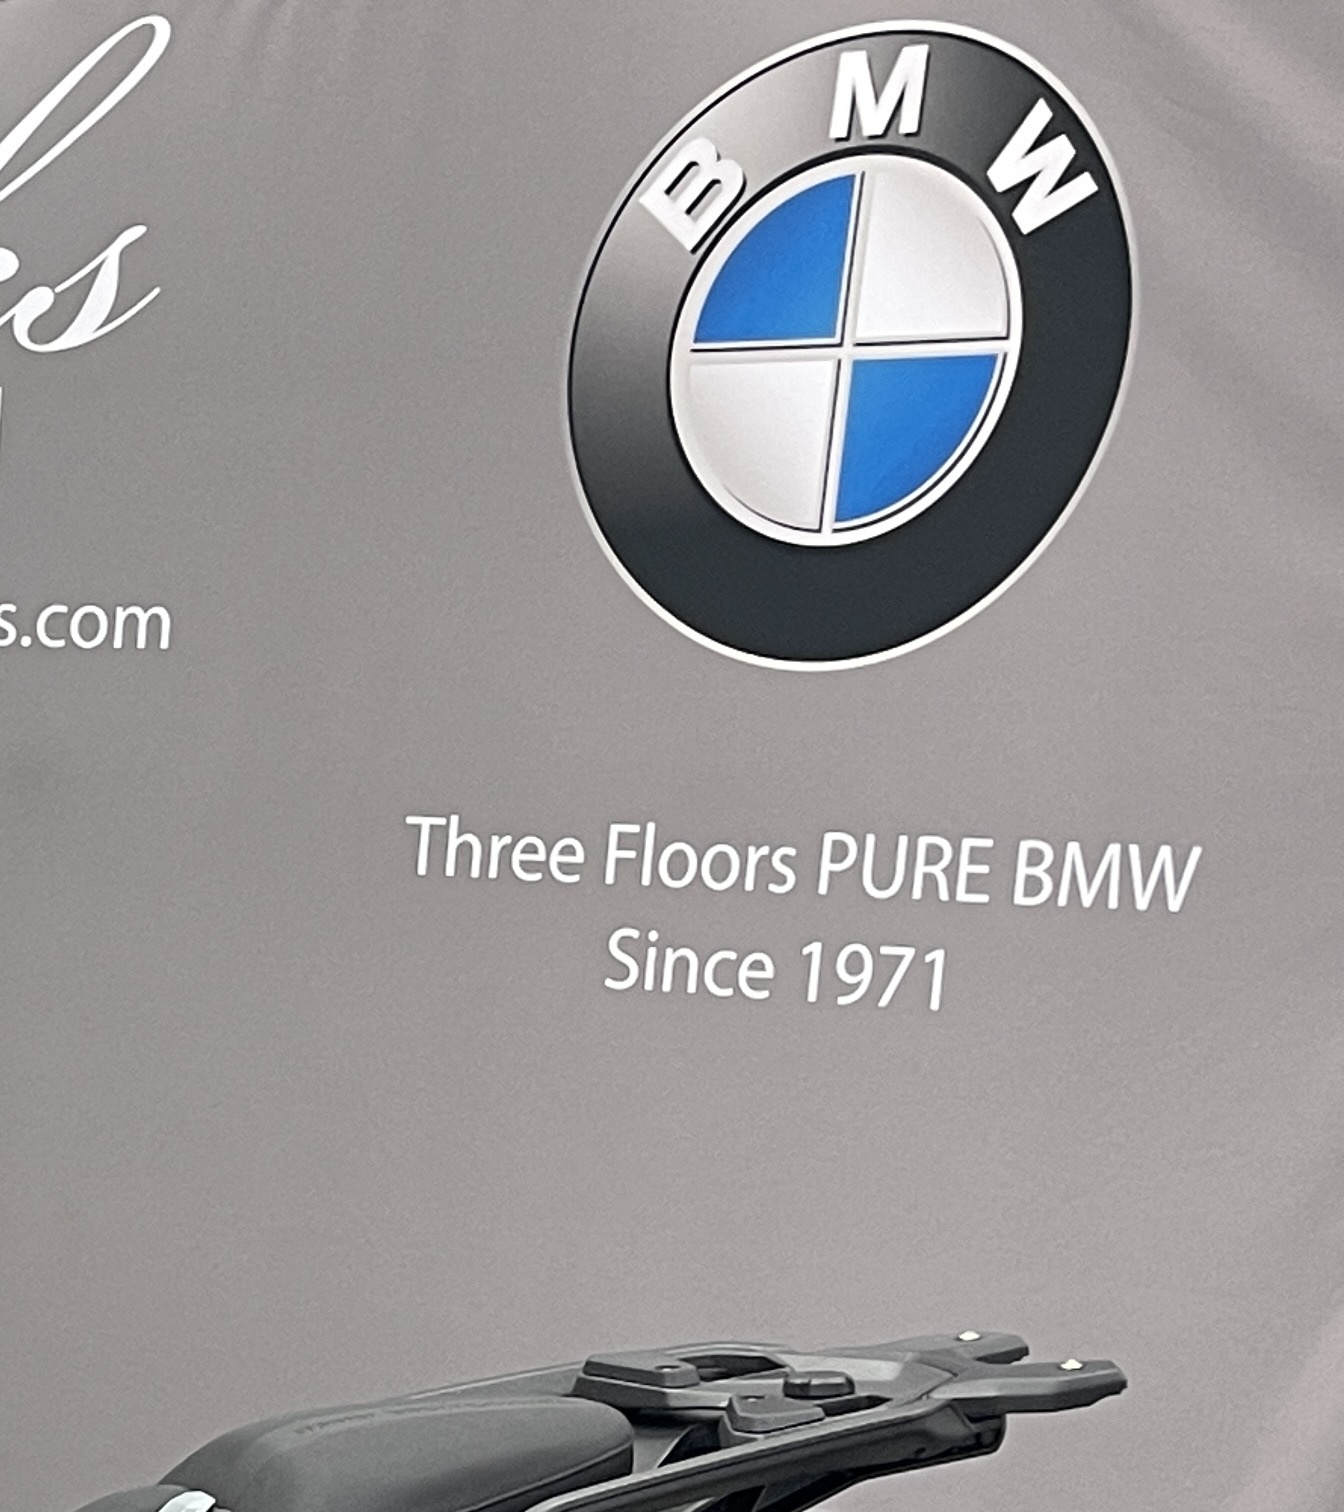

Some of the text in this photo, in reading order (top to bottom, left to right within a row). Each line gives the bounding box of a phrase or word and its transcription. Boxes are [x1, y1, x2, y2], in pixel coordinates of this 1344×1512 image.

[639, 44, 1098, 253] BMW
[404, 813, 1204, 914] Three Floors PURE BMW
[603, 926, 946, 1013] Since 1971
